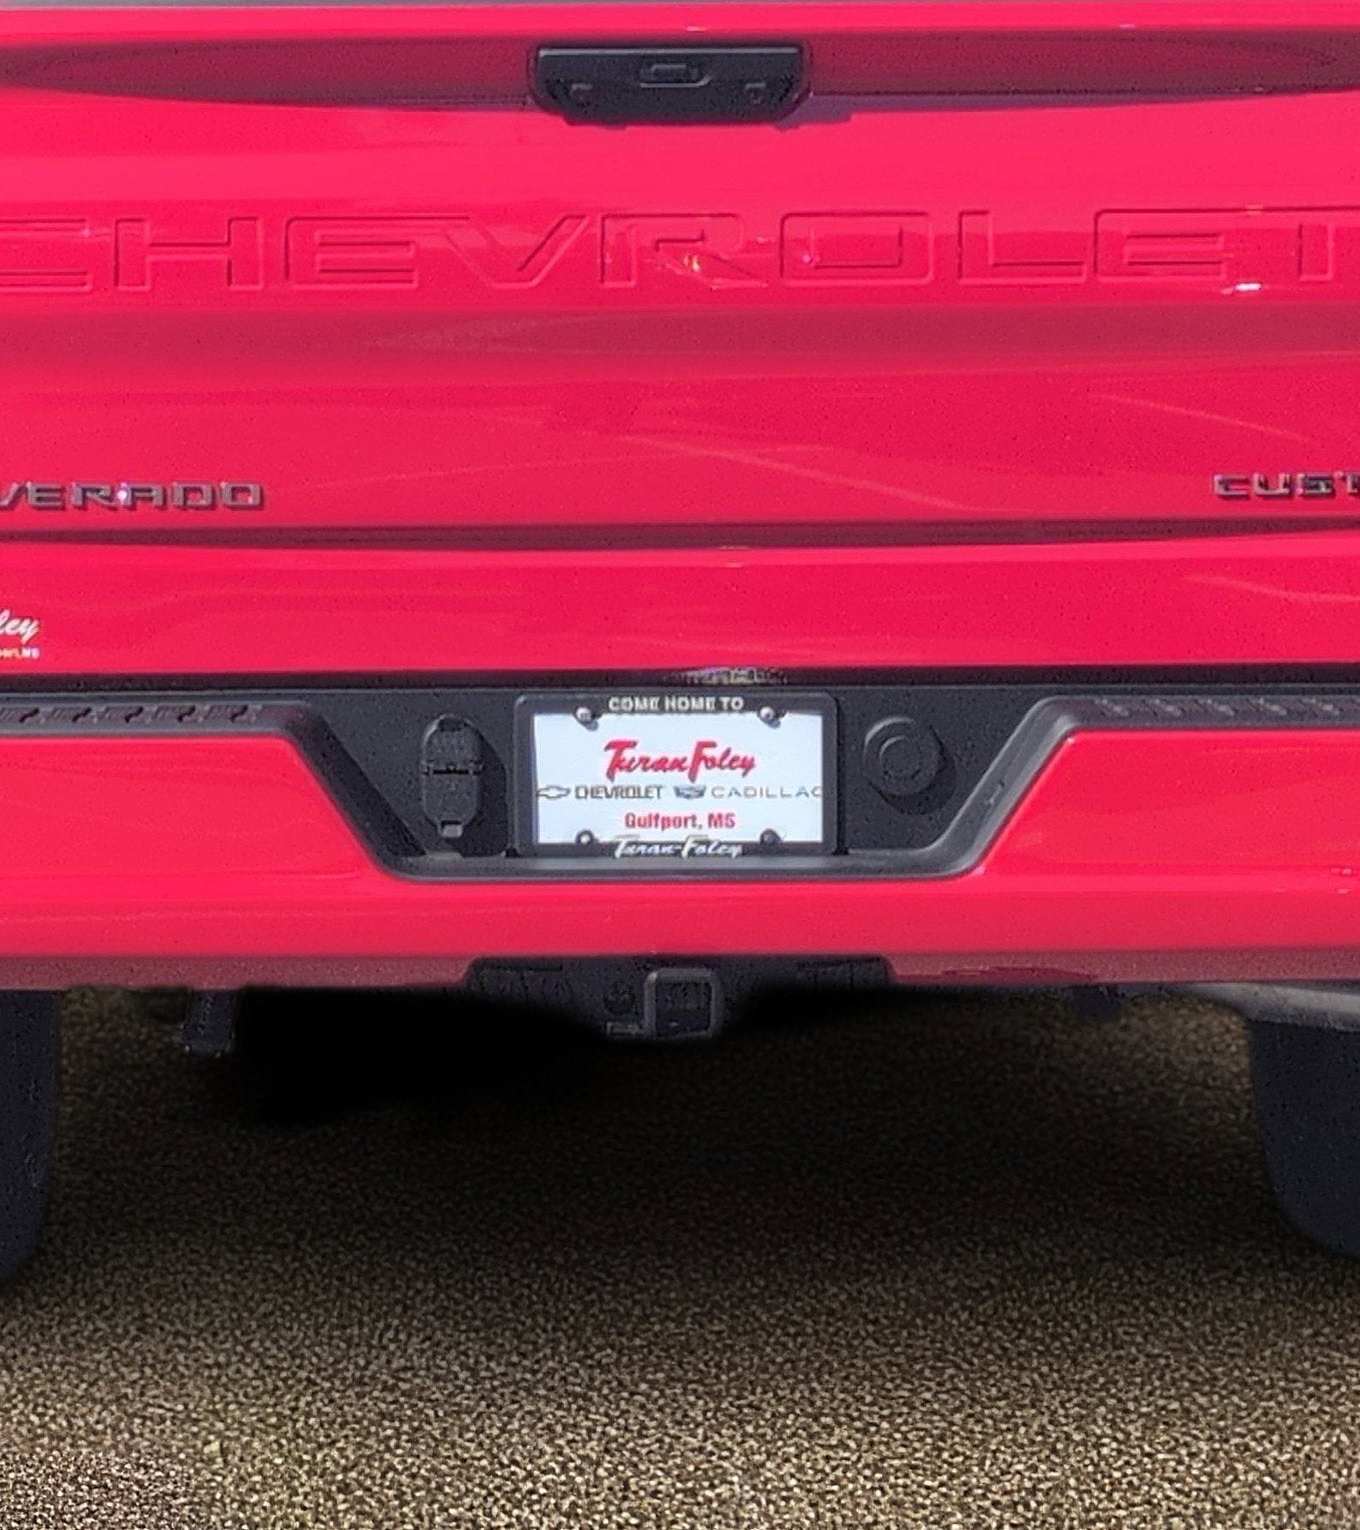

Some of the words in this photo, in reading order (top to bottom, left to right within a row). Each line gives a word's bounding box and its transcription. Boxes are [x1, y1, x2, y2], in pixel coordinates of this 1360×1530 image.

[608, 696, 660, 711] COME
[665, 696, 714, 711] HOME
[719, 696, 745, 711] TO
[575, 785, 663, 799] CHEVROLET
[711, 785, 822, 798] CADILLAC
[625, 813, 702, 831] Gulfport,
[708, 814, 736, 829] MS
